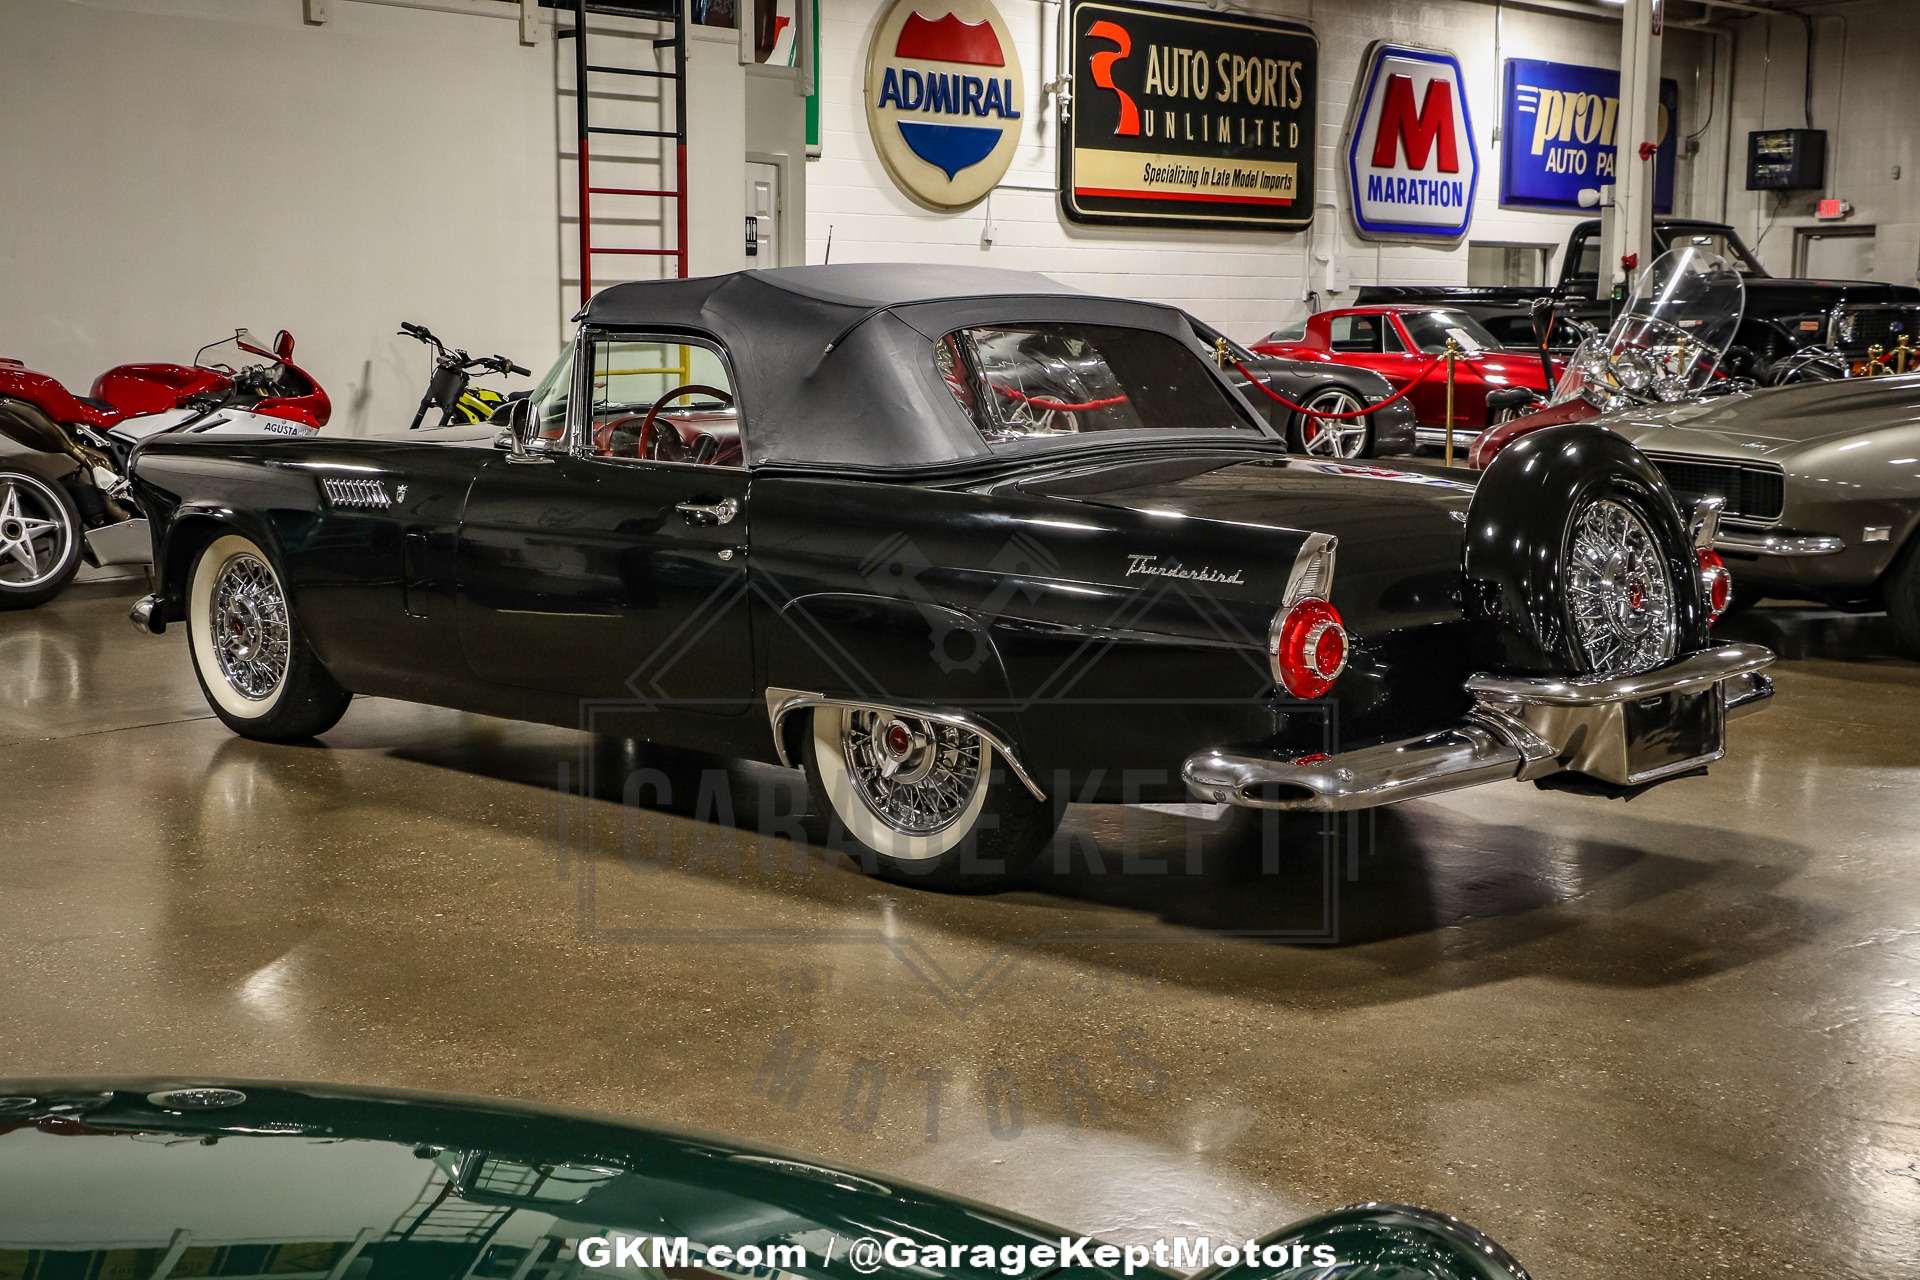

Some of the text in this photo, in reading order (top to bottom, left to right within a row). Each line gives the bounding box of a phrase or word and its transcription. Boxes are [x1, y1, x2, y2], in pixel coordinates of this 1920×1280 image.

[878, 66, 1020, 119] ADMIRAL
[1145, 44, 1302, 109] AUTO SPORTS
[1144, 109, 1299, 148] UNLIMITED
[1371, 73, 1459, 174] M
[1143, 162, 1293, 192] Specializing In Late Model Imports
[1545, 147, 1587, 175] AUTO
[1367, 174, 1463, 207] MARATHON
[264, 423, 298, 435] AGUSTA
[1126, 554, 1245, 585] Thunderbird
